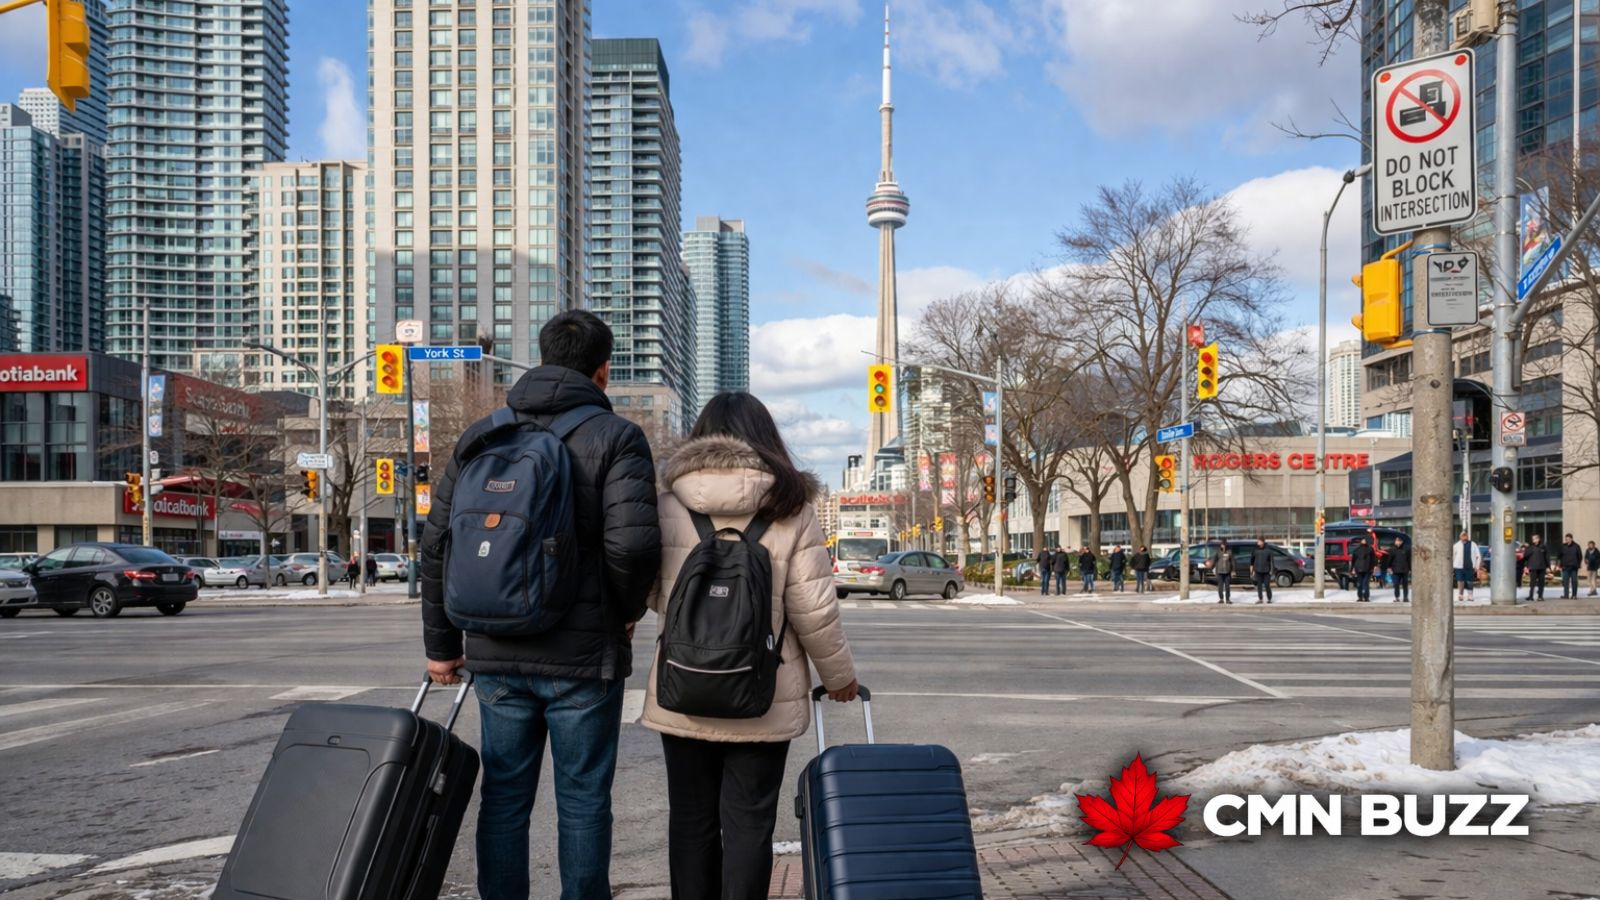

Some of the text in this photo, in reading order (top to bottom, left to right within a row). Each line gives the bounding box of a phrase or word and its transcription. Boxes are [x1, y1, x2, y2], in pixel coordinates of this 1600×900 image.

[1386, 146, 1459, 177] DO NOT
[1392, 169, 1455, 198] BLOCK
[1380, 189, 1470, 222] INTERSECTION
[424, 348, 465, 359] York St
[1192, 453, 1282, 470] ROGERS
